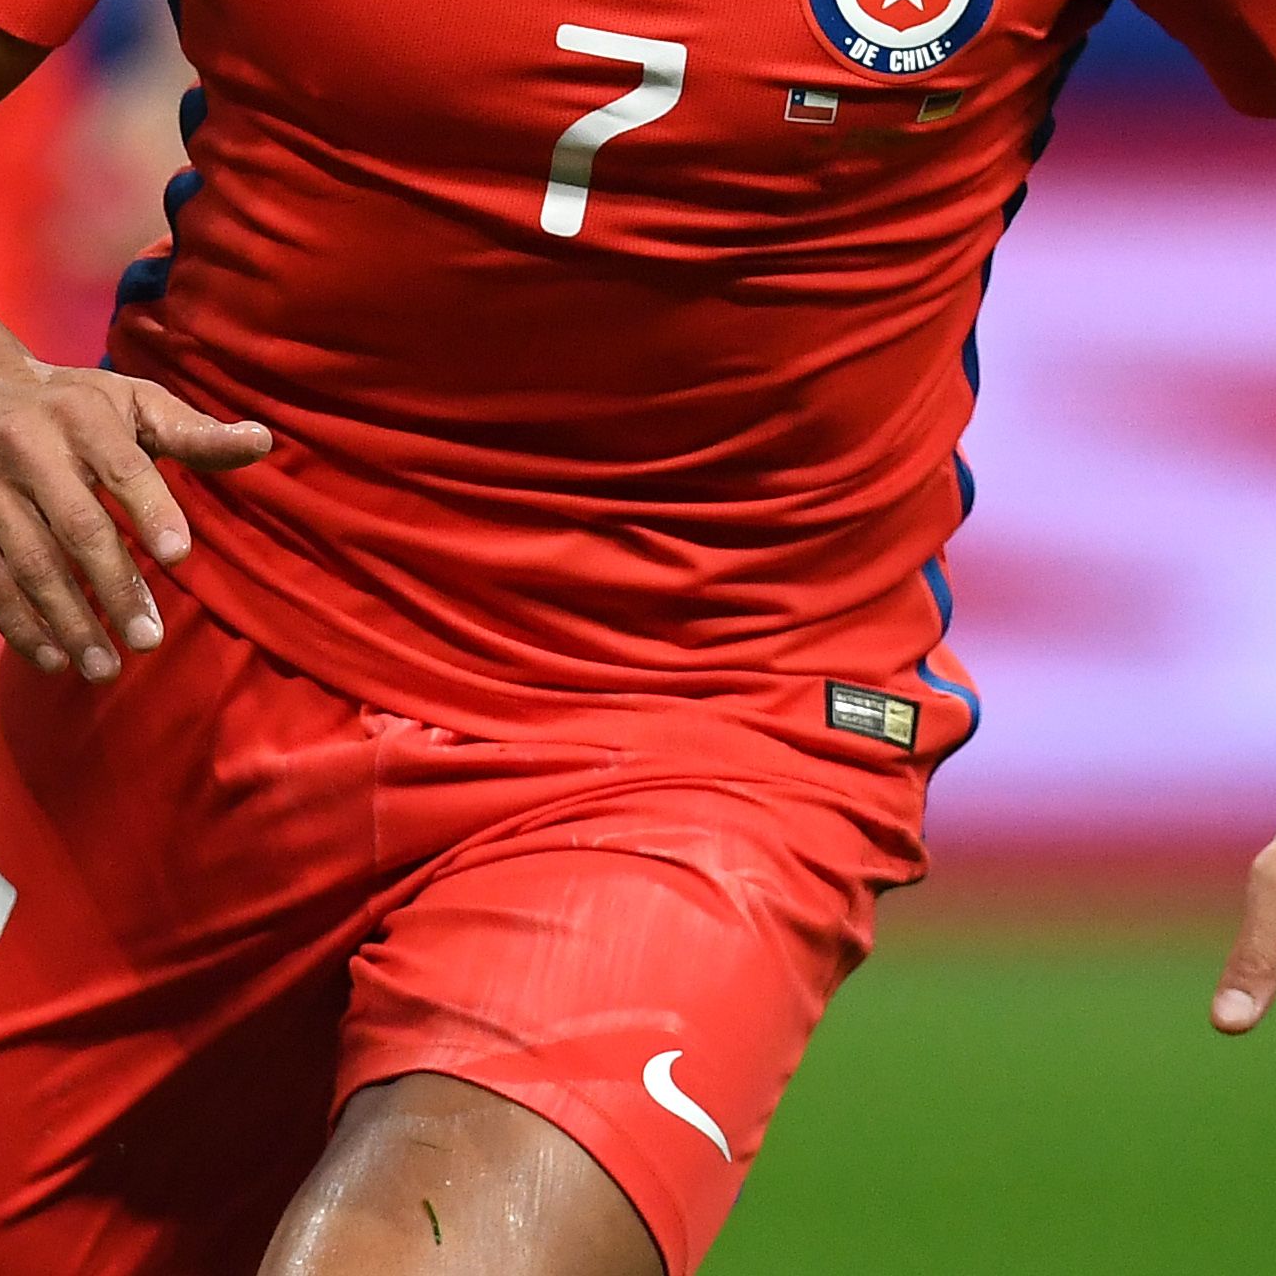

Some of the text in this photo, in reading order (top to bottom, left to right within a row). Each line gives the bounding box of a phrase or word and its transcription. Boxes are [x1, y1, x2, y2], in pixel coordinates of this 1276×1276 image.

[848, 40, 946, 72] DE CHILE
[540, 23, 688, 238] 7
